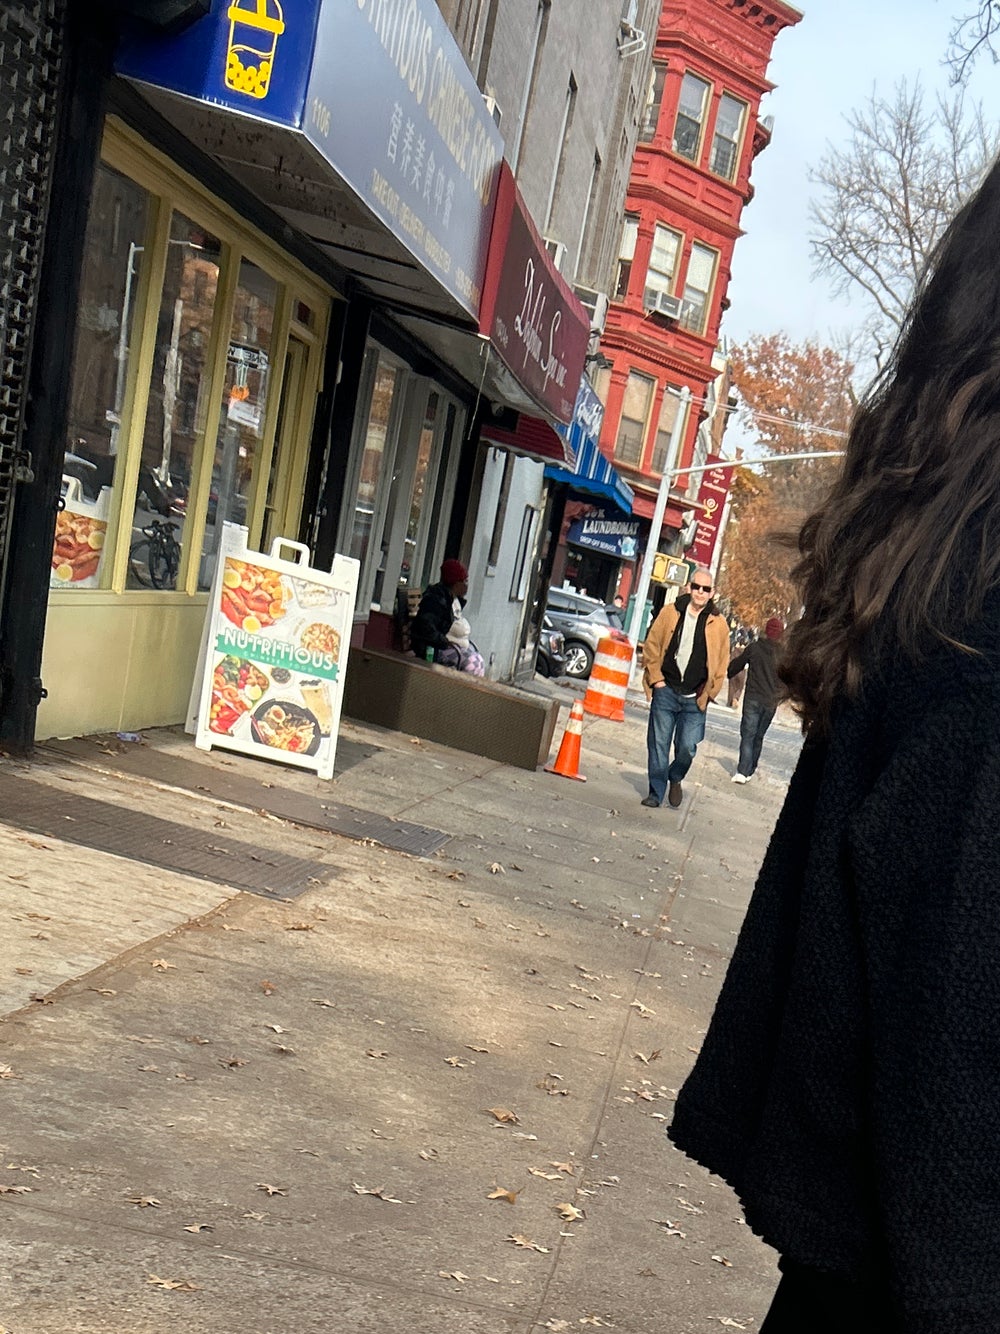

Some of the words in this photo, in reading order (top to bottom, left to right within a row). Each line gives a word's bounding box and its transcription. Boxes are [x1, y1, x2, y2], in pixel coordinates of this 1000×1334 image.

[427, 46, 476, 174] CHINESE
[466, 118, 497, 207] FOOD
[582, 519, 640, 535] LAUNDROMAT
[224, 626, 334, 671] NUTRITIOUS
